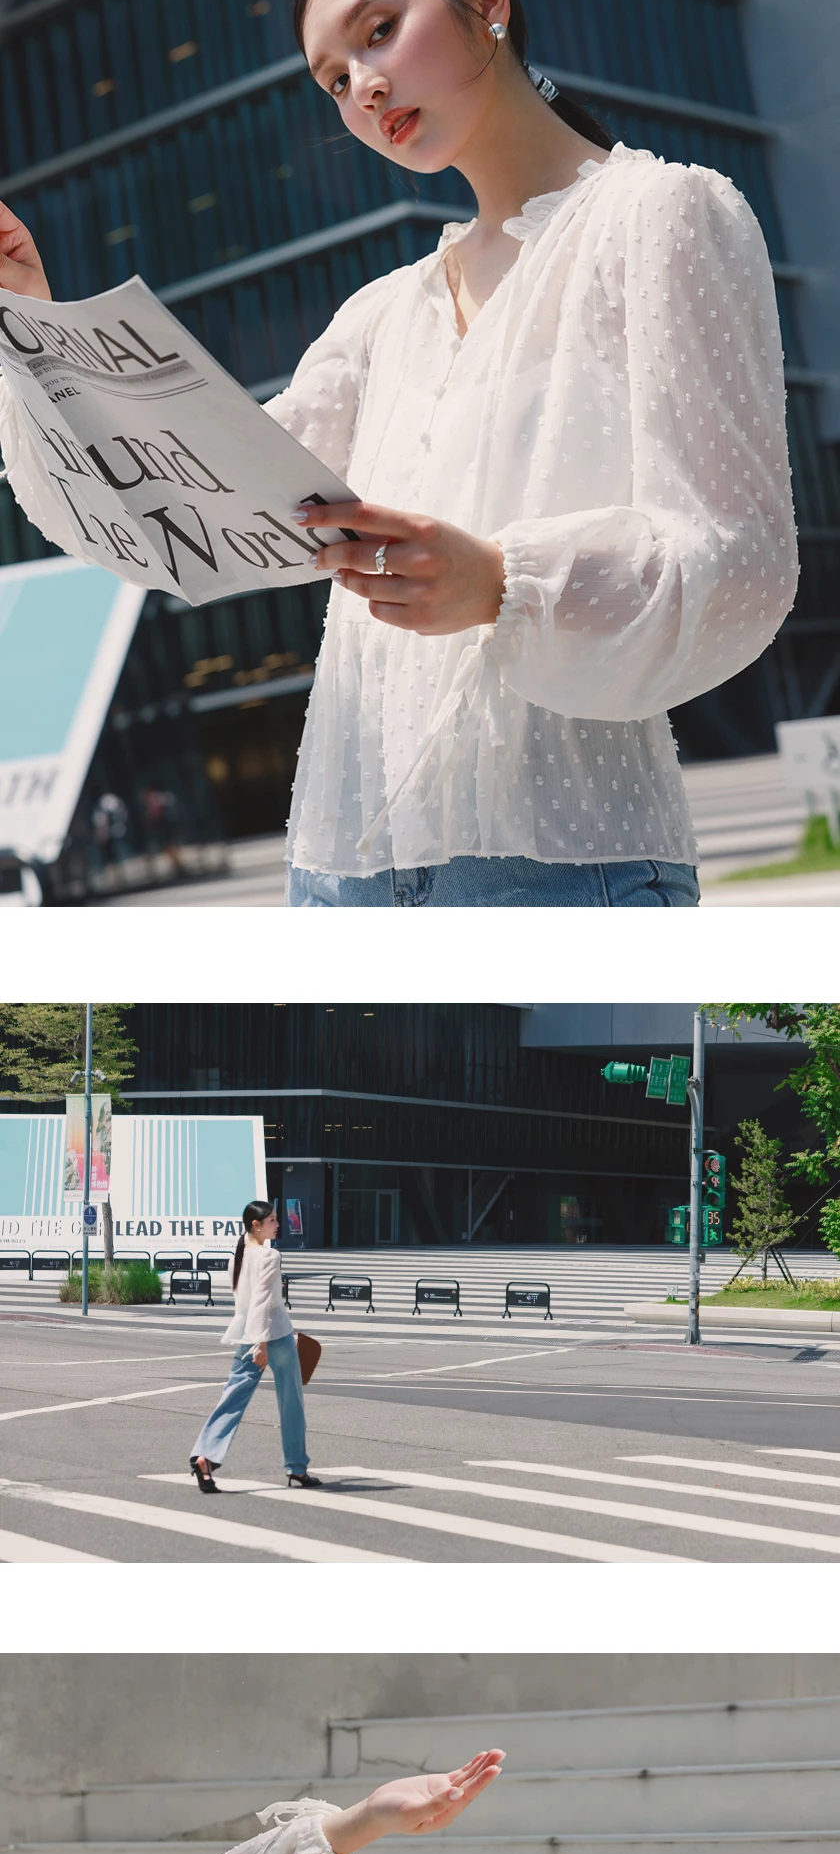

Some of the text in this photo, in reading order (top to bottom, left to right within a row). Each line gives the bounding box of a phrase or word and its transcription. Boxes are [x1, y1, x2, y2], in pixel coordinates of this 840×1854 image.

[708, 1211, 720, 1225] 35
[115, 1220, 162, 1236] LEAD
[169, 1220, 204, 1236] THE
[212, 1220, 244, 1236] PAT
